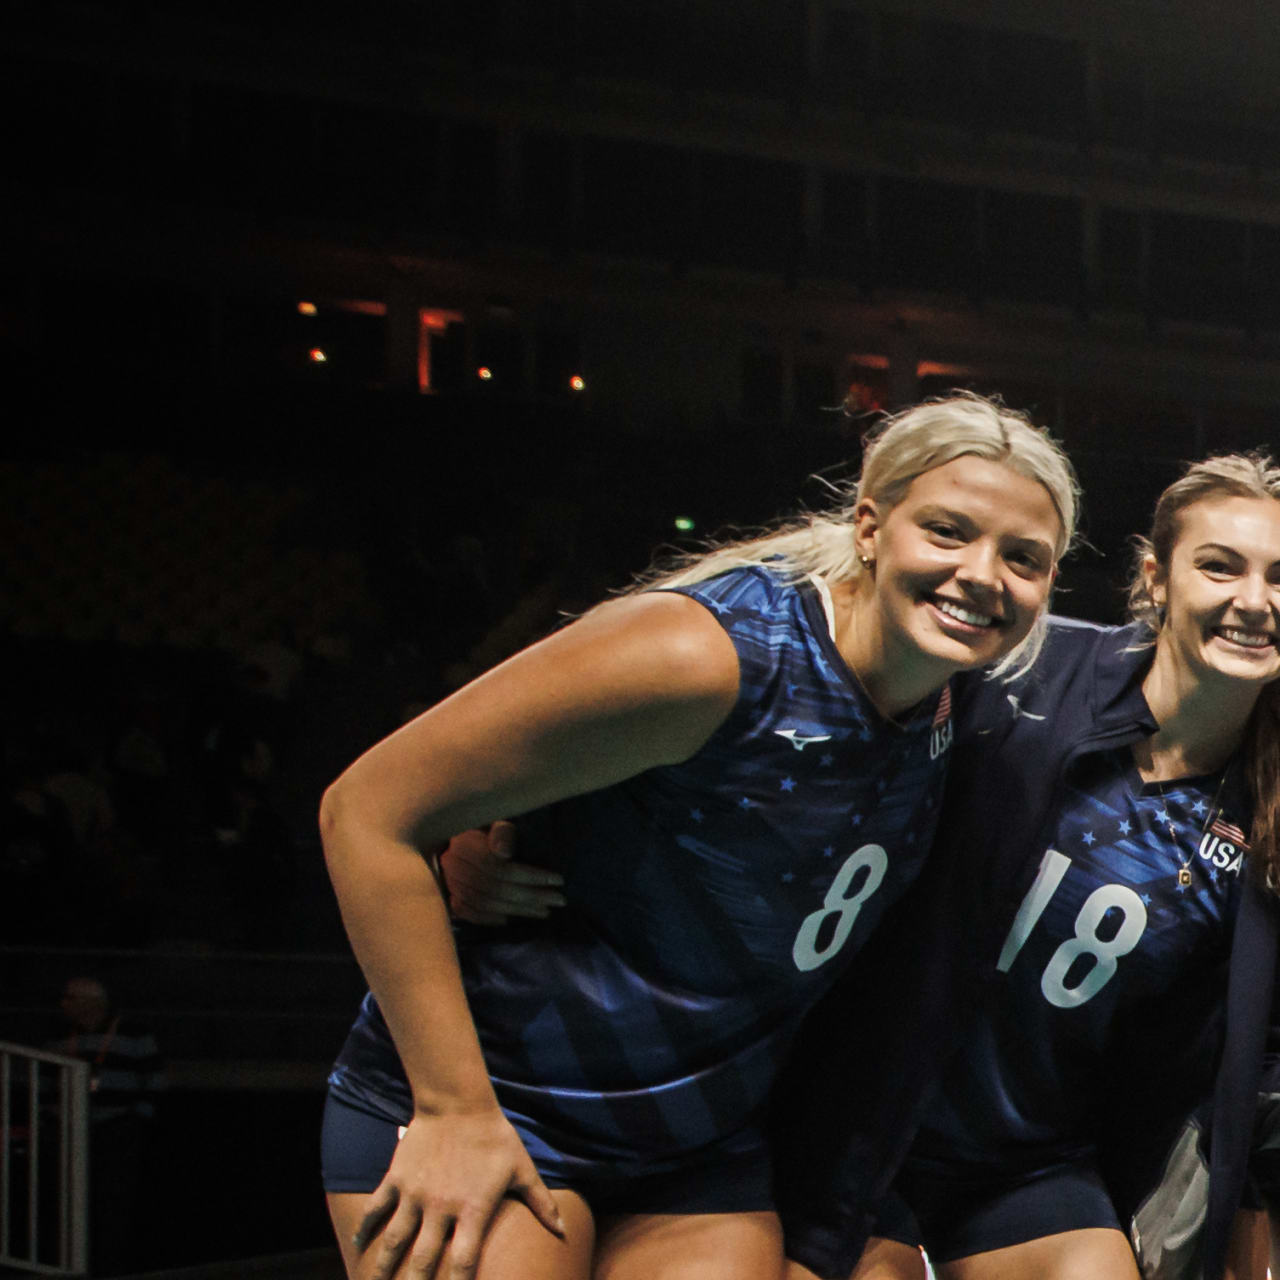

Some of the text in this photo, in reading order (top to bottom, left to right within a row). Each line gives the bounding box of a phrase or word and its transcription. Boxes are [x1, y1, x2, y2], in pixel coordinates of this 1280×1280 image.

[792, 844, 888, 972] 8
[1199, 832, 1243, 878] USA
[996, 849, 1147, 1009] 18
